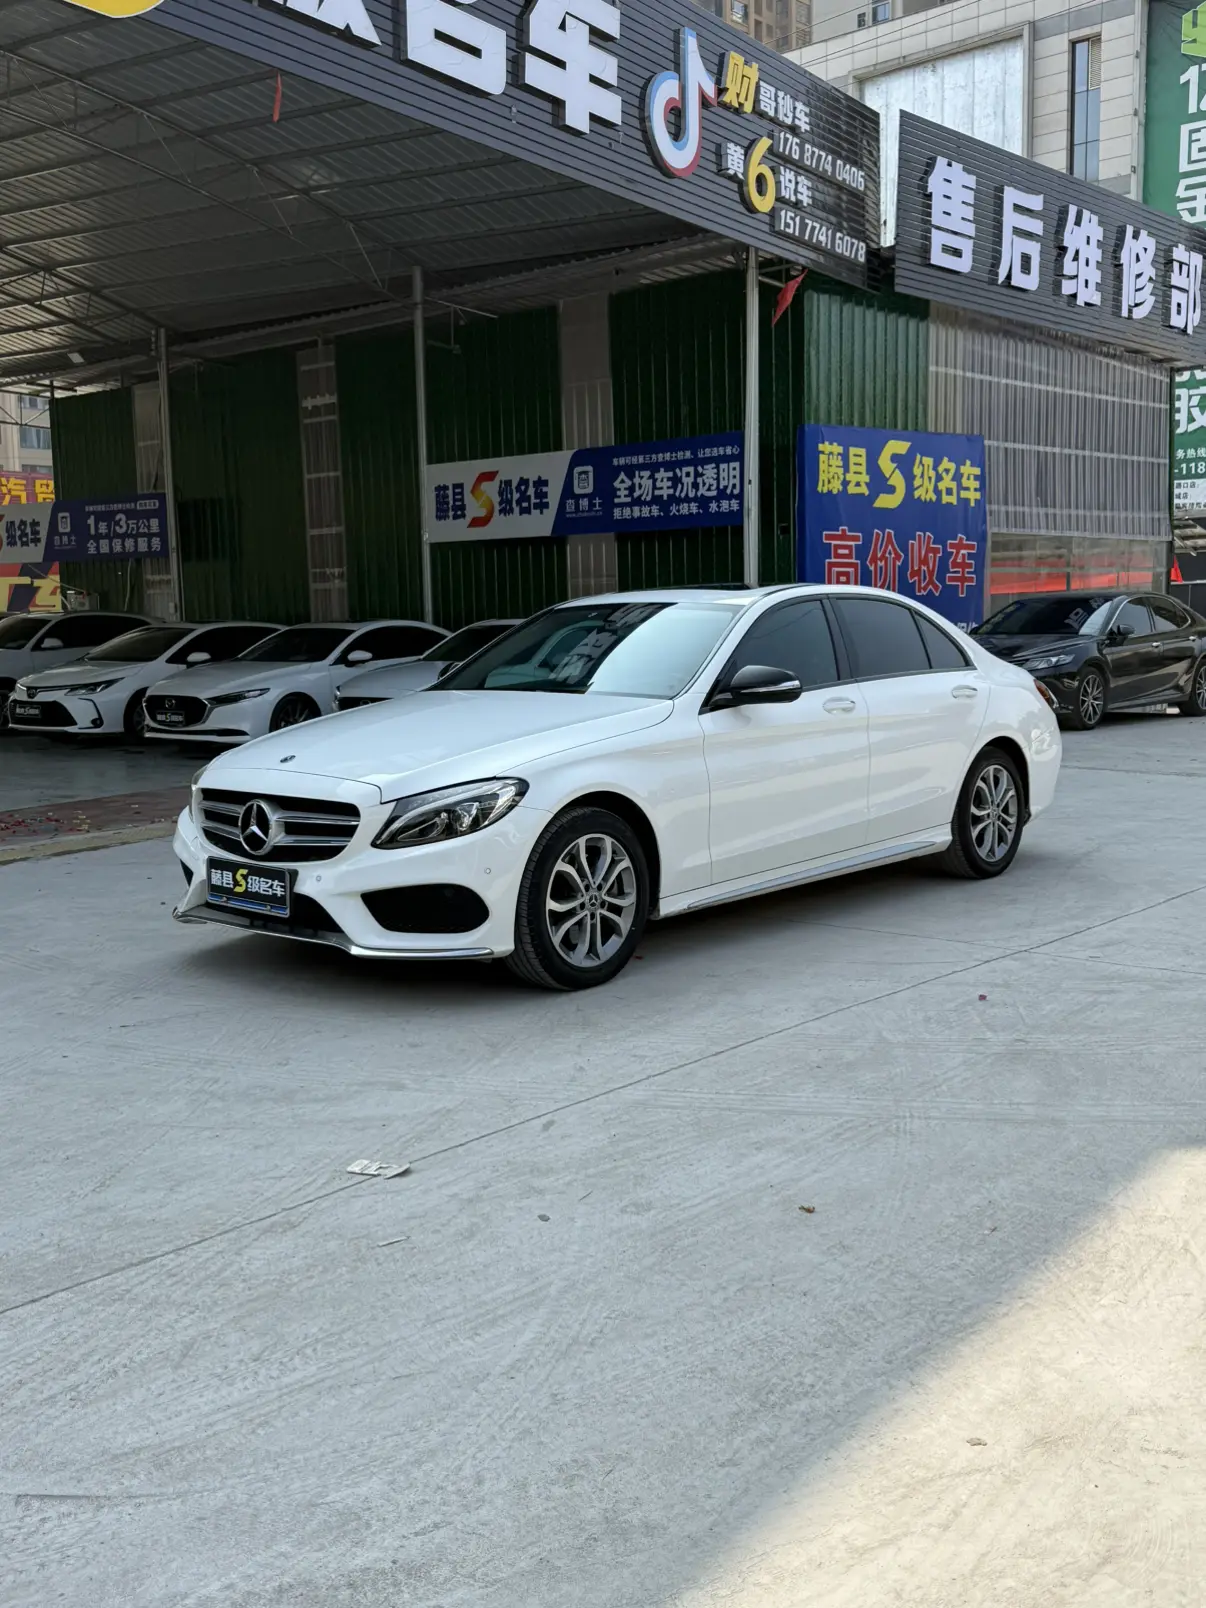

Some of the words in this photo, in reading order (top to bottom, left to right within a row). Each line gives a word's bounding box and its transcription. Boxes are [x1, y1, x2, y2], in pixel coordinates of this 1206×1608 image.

[778, 131, 800, 160] 176
[803, 143, 832, 176] 8774
[836, 159, 865, 191] 0406
[779, 208, 800, 237] 151
[804, 216, 831, 248] 7741
[834, 234, 866, 262] 6078
[927, 156, 1203, 335] 售后维修部
[613, 462, 741, 504] 全场车况透明
[0, 514, 42, 549] 级名车
[87, 537, 162, 554] 全国保修服务
[822, 526, 978, 597] 高价收车
